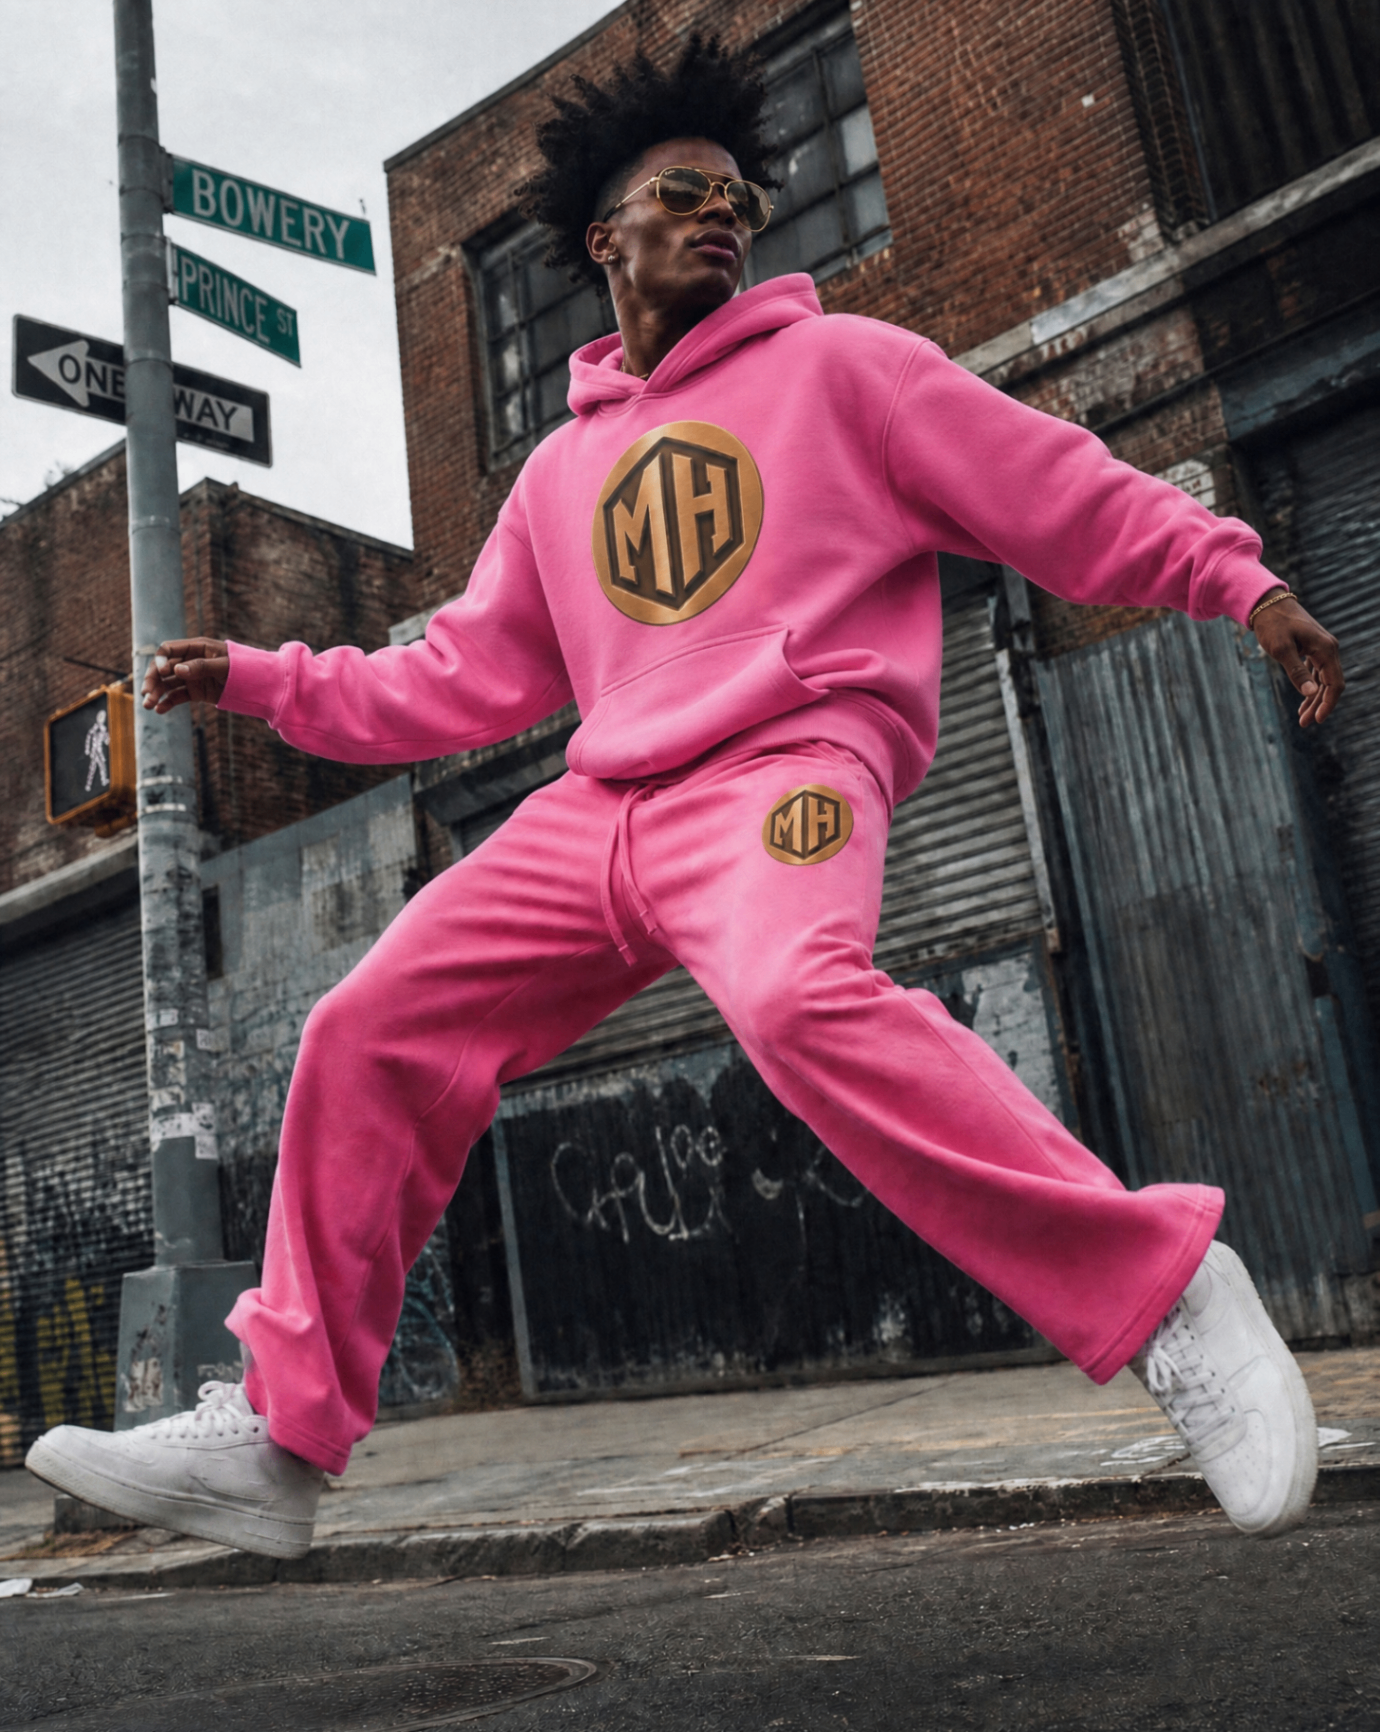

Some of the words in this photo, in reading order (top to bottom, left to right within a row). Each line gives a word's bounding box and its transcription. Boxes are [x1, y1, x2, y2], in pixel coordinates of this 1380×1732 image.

[192, 169, 350, 260] BOWERY
[180, 255, 270, 344] PRINCE
[276, 308, 294, 337] ST
[58, 353, 125, 399] ONE
[173, 387, 239, 432] WAY
[611, 452, 735, 598] MH
[773, 795, 838, 856] MH
